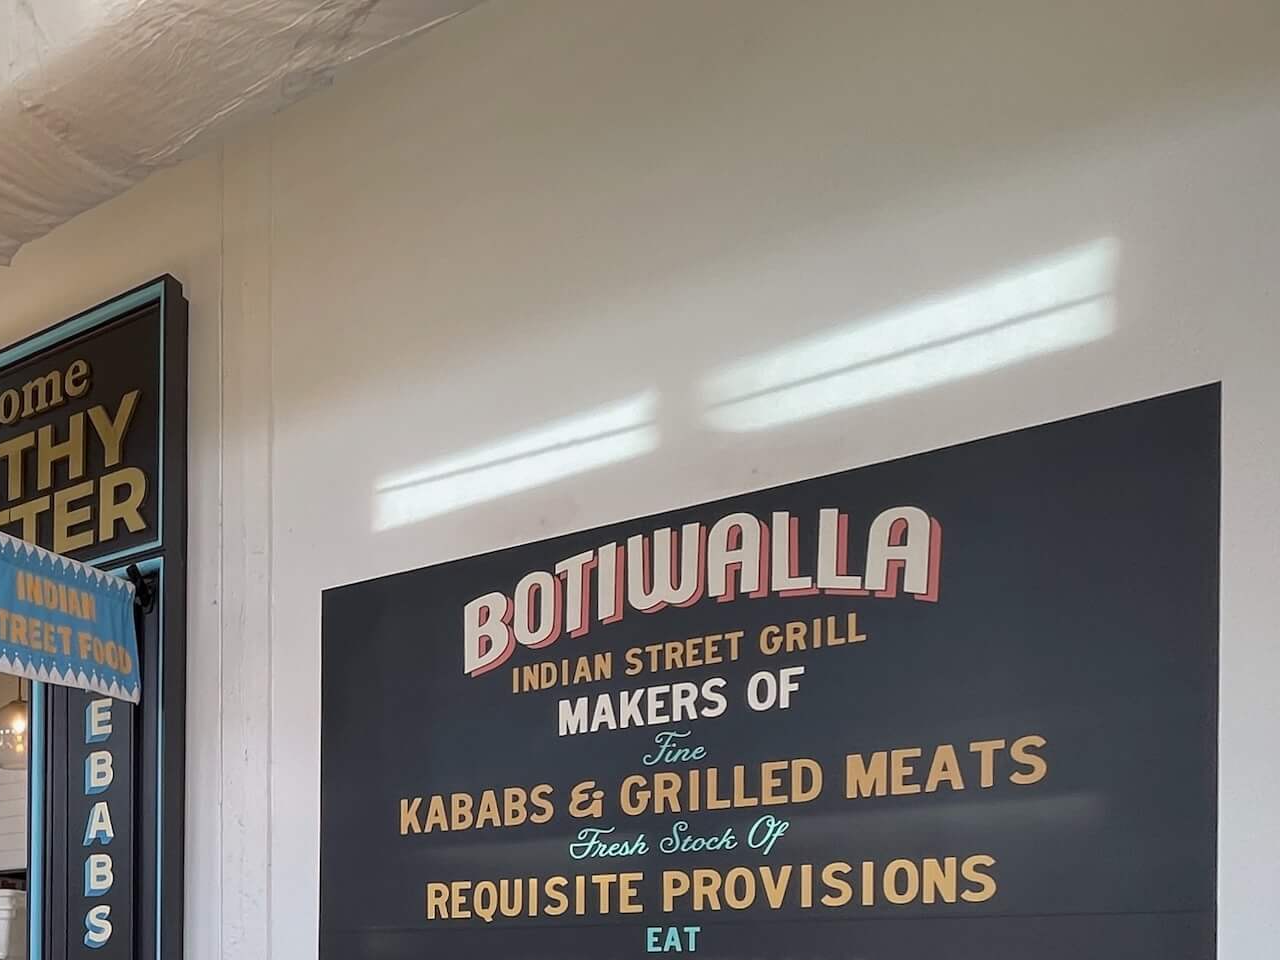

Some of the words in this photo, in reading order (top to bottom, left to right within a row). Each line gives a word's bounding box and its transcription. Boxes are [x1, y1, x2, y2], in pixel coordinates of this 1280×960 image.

[15, 570, 97, 622] INDIAN
[463, 505, 942, 678] BOTIWALLA
[77, 631, 132, 676] FOOD
[511, 652, 613, 694] INDIAN
[624, 631, 746, 677] STREET
[758, 612, 868, 655] GRILL
[557, 677, 728, 737] MAKERS
[746, 666, 806, 712] OF
[643, 730, 706, 768] Fine
[399, 785, 555, 836] KABABS
[567, 780, 606, 820] &
[620, 757, 824, 817] GRILLED
[845, 736, 1048, 799] MEATS
[82, 697, 115, 948] EBABS
[569, 828, 648, 861] Fresh
[660, 821, 737, 854] Stock
[747, 815, 790, 854] Of
[426, 871, 644, 923] REQUISITE
[662, 854, 998, 913] PROVISIONS
[646, 925, 701, 953] EAT
